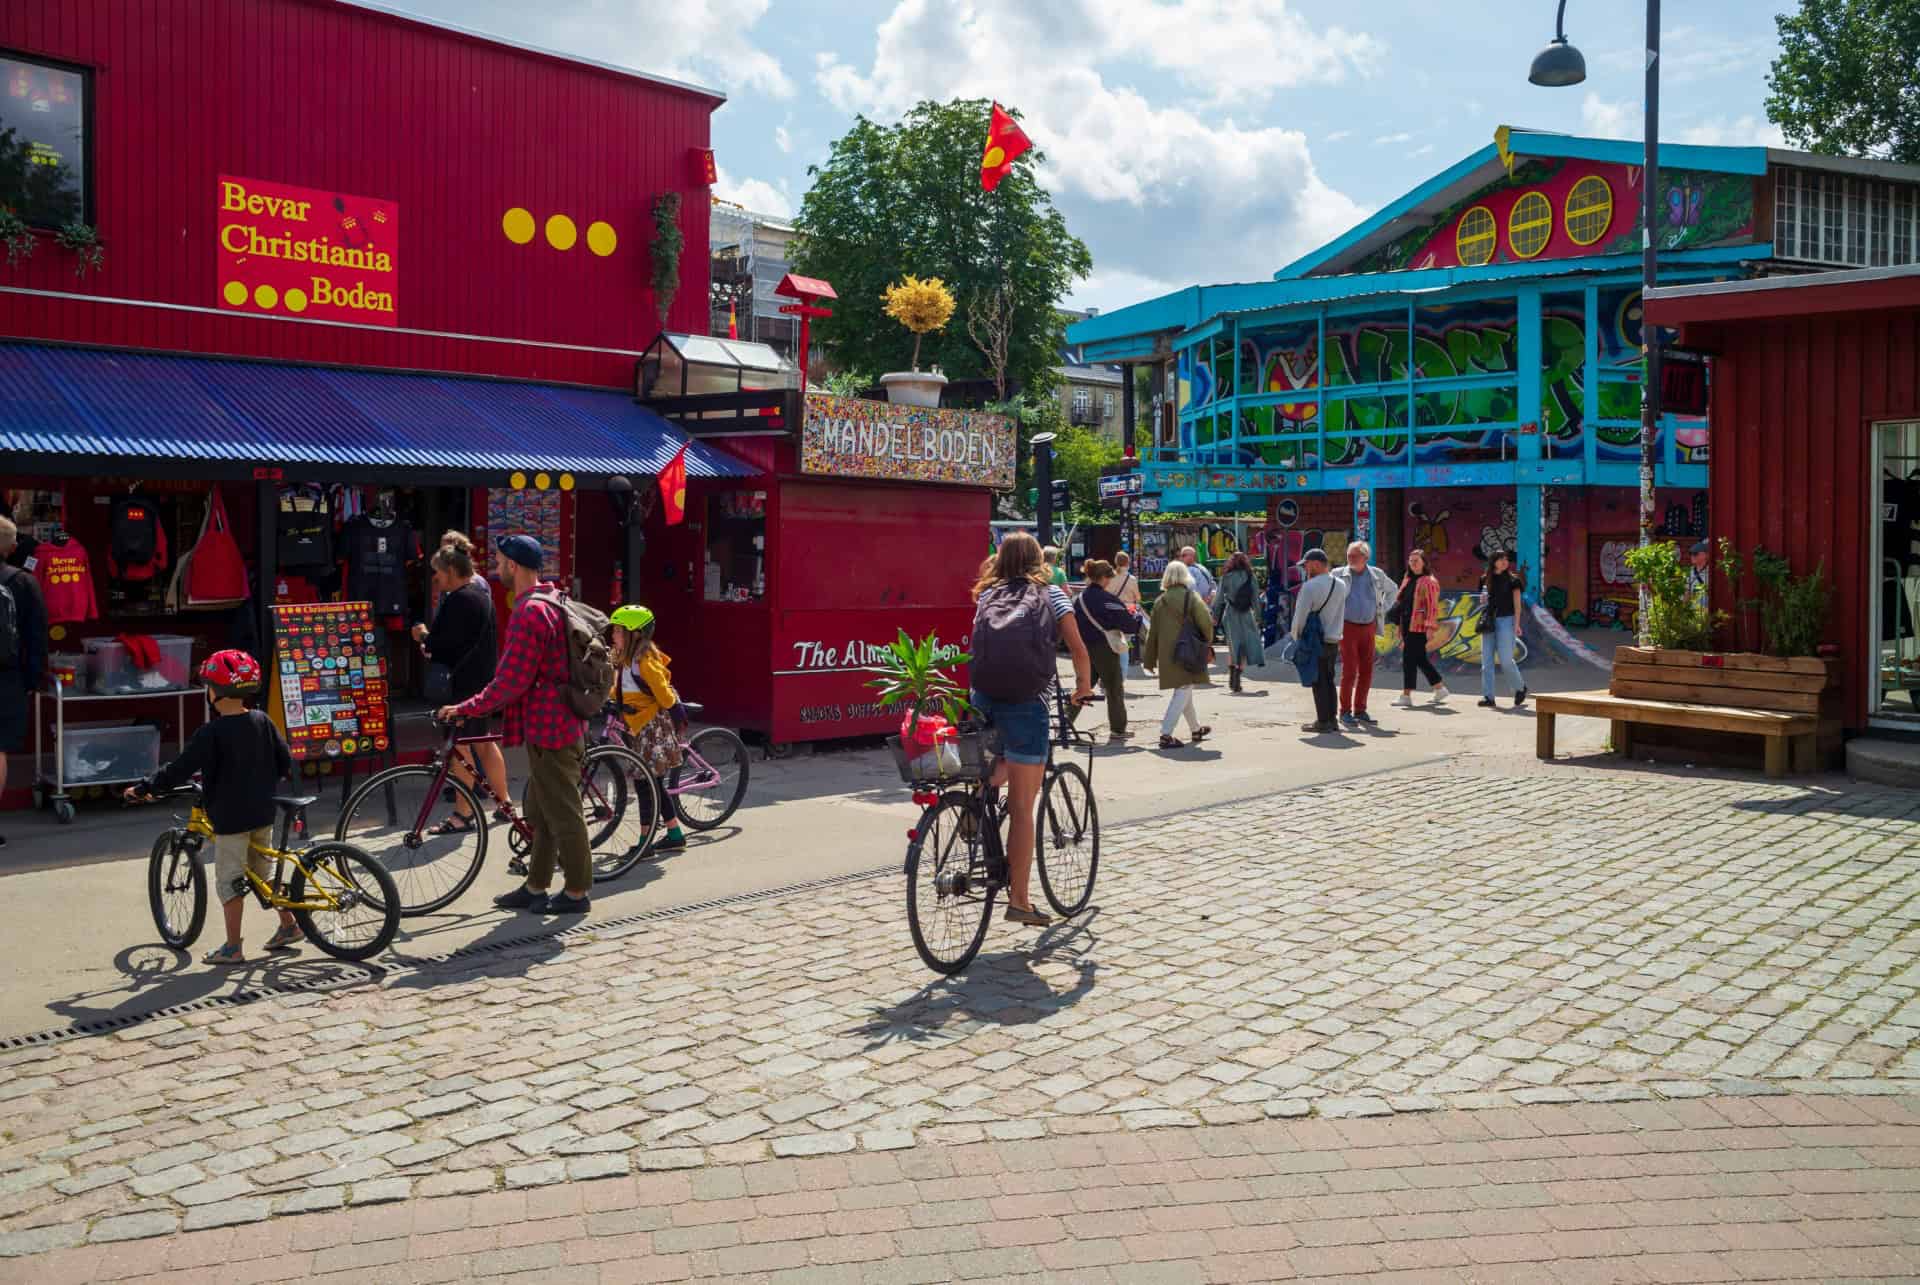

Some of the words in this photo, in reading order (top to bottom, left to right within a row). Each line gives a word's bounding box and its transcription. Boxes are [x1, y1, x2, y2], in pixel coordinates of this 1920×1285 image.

[222, 181, 311, 221] Bevar
[221, 224, 392, 272] Christiania
[311, 276, 394, 312] Boden
[822, 417, 997, 466] MANDELBODEN
[793, 641, 837, 667] The
